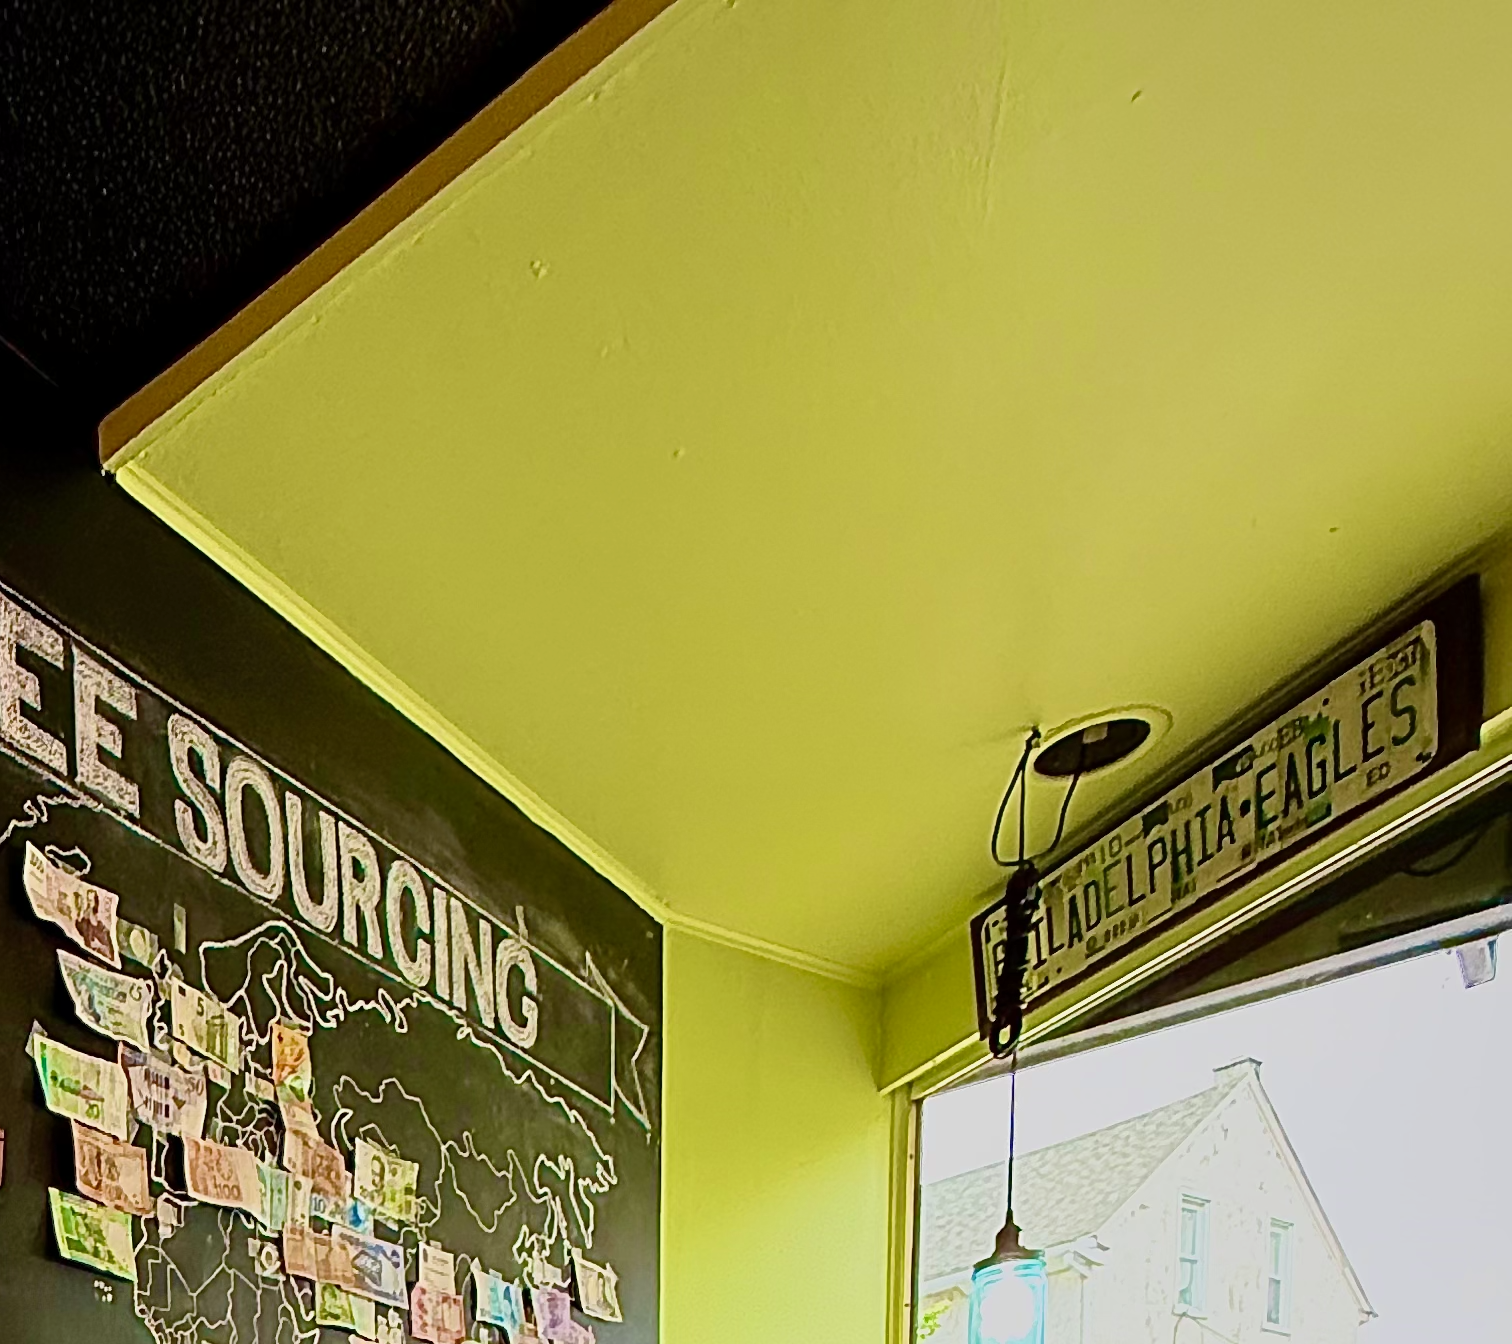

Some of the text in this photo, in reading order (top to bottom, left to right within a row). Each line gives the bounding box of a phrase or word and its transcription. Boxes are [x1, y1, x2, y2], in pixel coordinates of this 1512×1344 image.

[166, 711, 540, 1048] SOURCING
[990, 796, 1236, 976] PILADELPHIA
[196, 998, 205, 1017] 5
